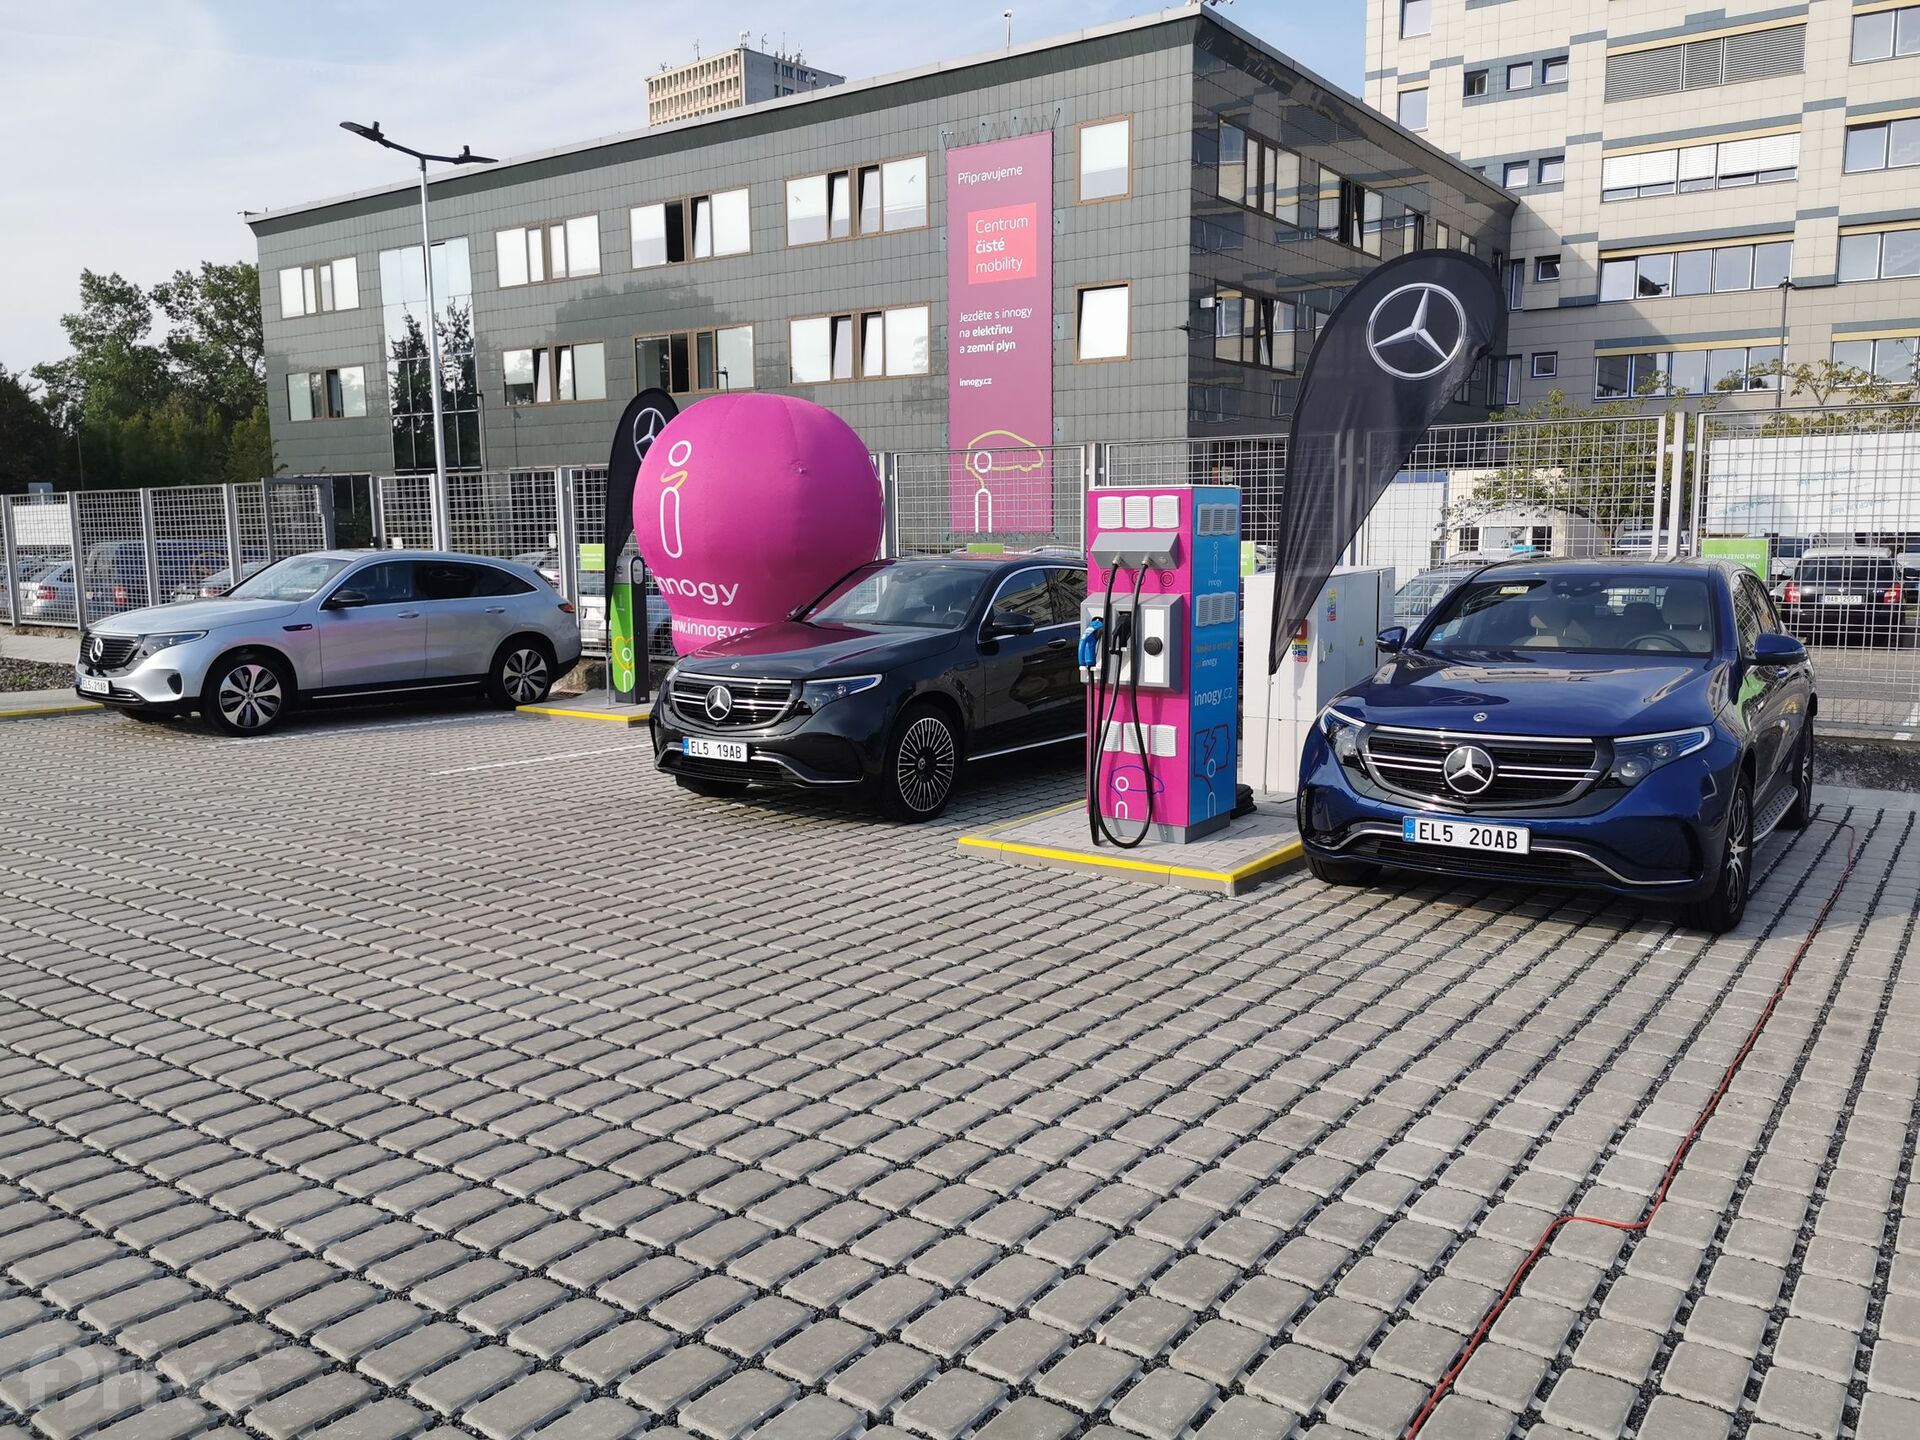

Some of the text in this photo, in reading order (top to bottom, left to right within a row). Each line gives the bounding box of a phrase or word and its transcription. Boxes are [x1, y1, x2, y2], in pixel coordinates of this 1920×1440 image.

[958, 165, 1023, 185] Připravujeme
[976, 216, 1028, 234] Centrum
[976, 237, 1005, 254] čisté
[976, 256, 1023, 274] mobility
[960, 310, 992, 323] Jezděte
[1002, 306, 1033, 320] innogy
[960, 323, 1013, 338] na elektřinu
[960, 340, 1016, 354] a zemní plyn
[959, 377, 992, 388] innogy.cz
[1194, 686, 1232, 706] innogy.cz
[691, 741, 709, 755] EL5
[716, 744, 742, 759] 19AB
[1419, 822, 1454, 842] EL5
[1469, 827, 1518, 850] 20AB
